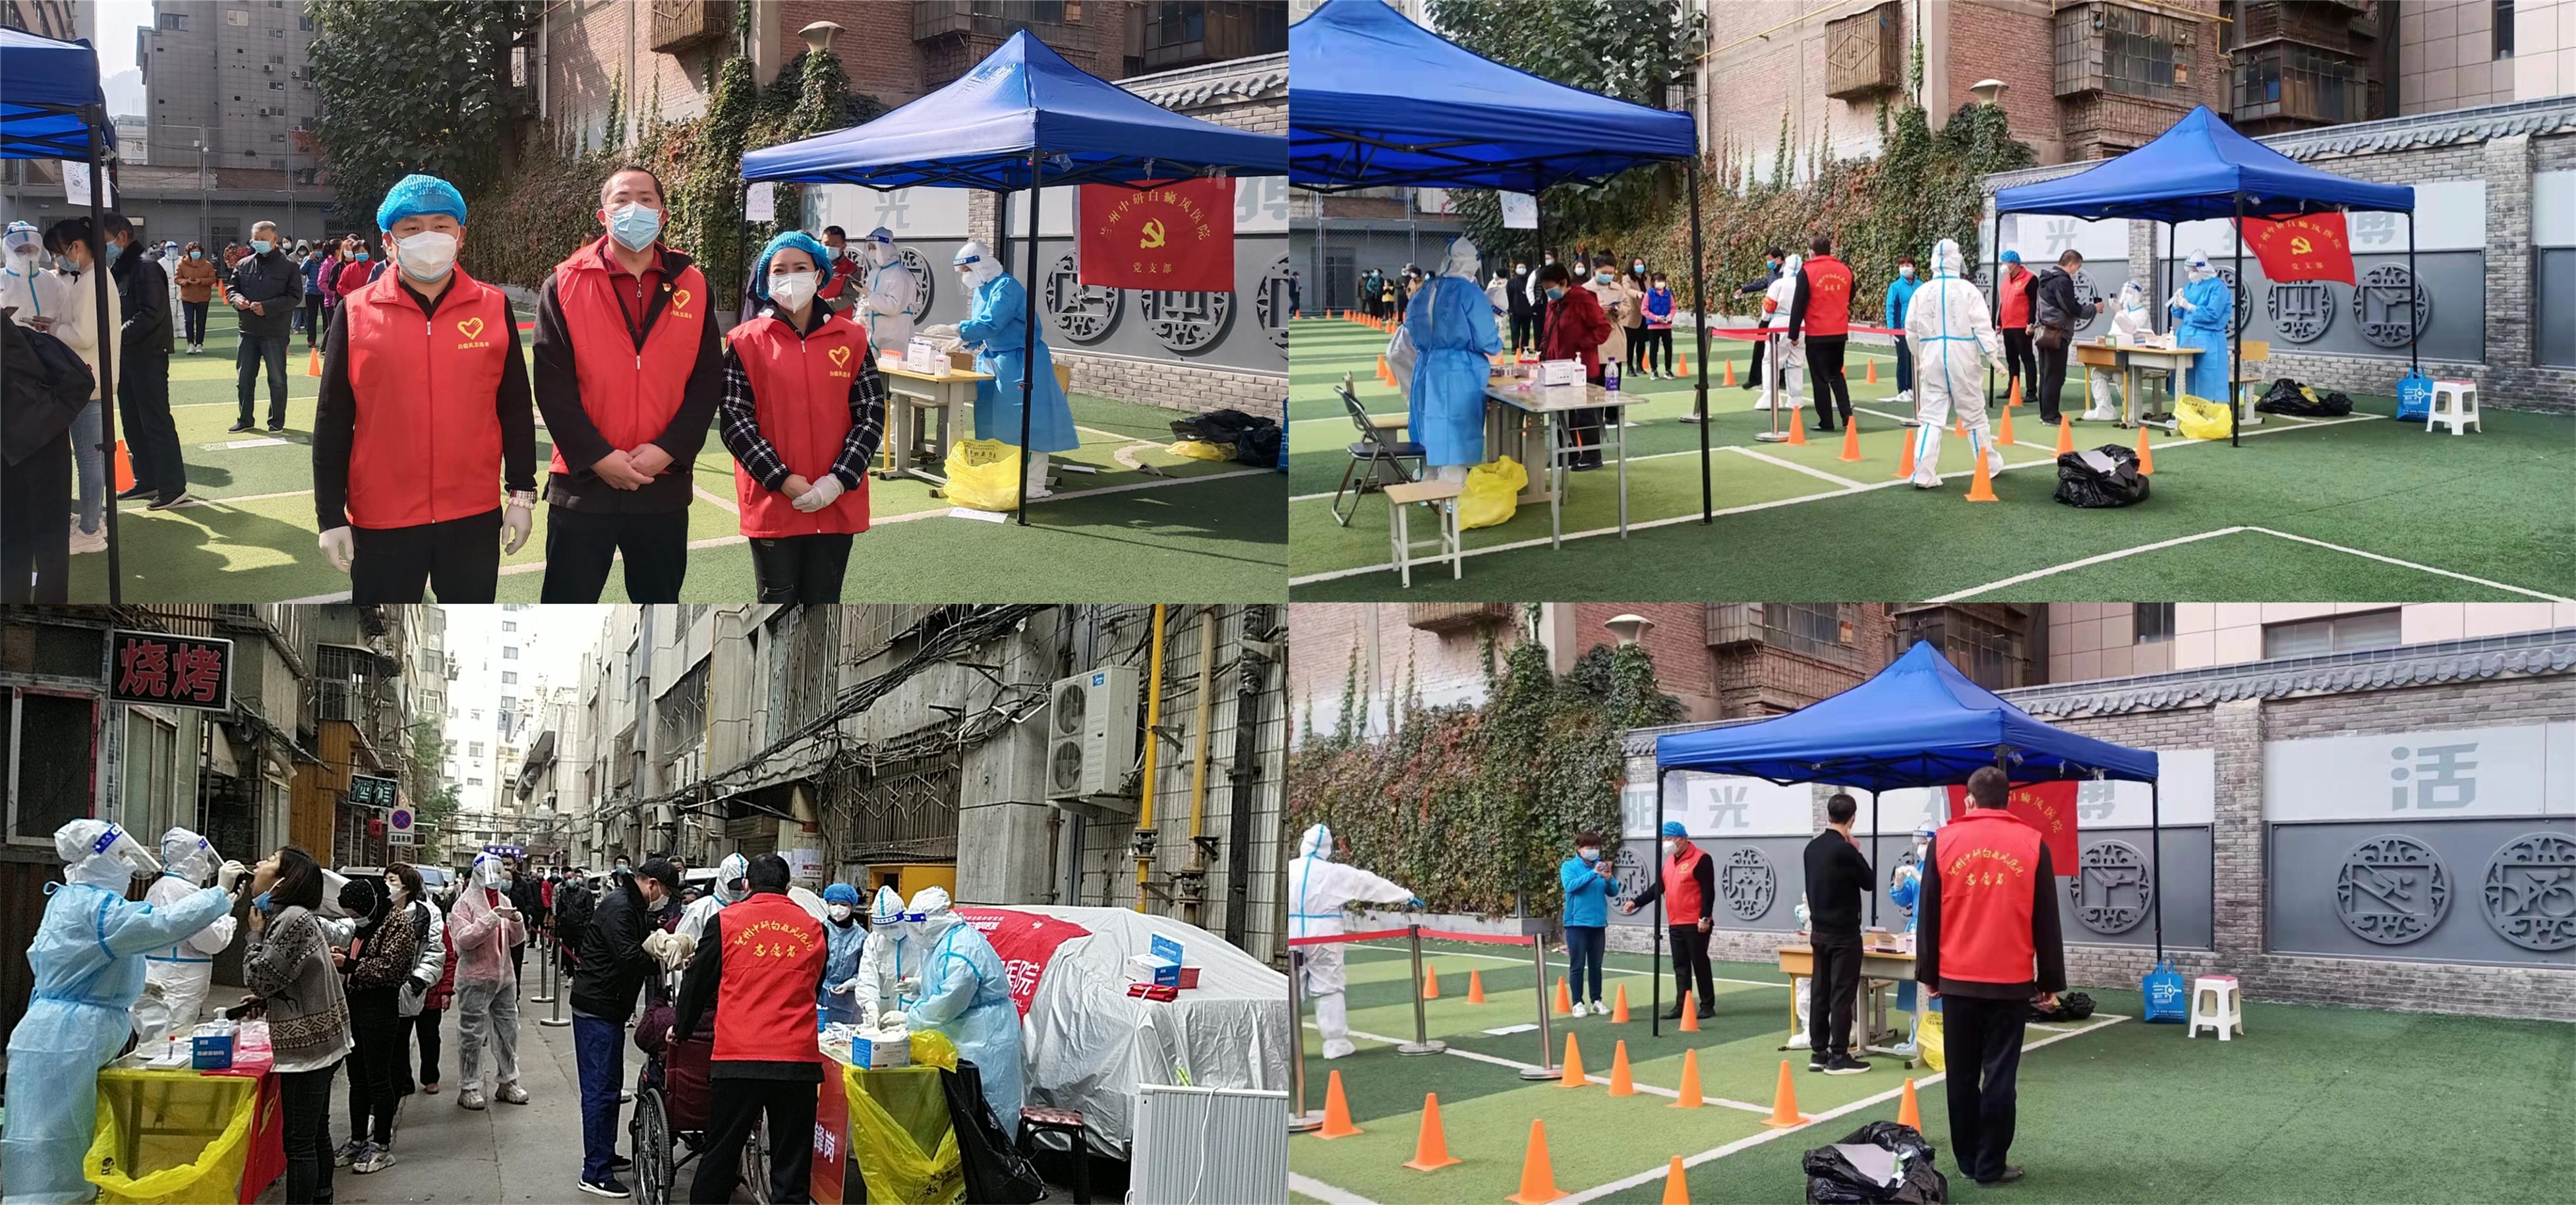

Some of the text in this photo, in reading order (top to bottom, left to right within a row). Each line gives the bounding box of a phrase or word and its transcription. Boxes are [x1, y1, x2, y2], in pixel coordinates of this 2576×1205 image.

[1132, 262, 1172, 274] 党支部
[119, 637, 221, 702] 烧烤
[351, 777, 395, 806] 酒馆
[2391, 742, 2479, 811] 活
